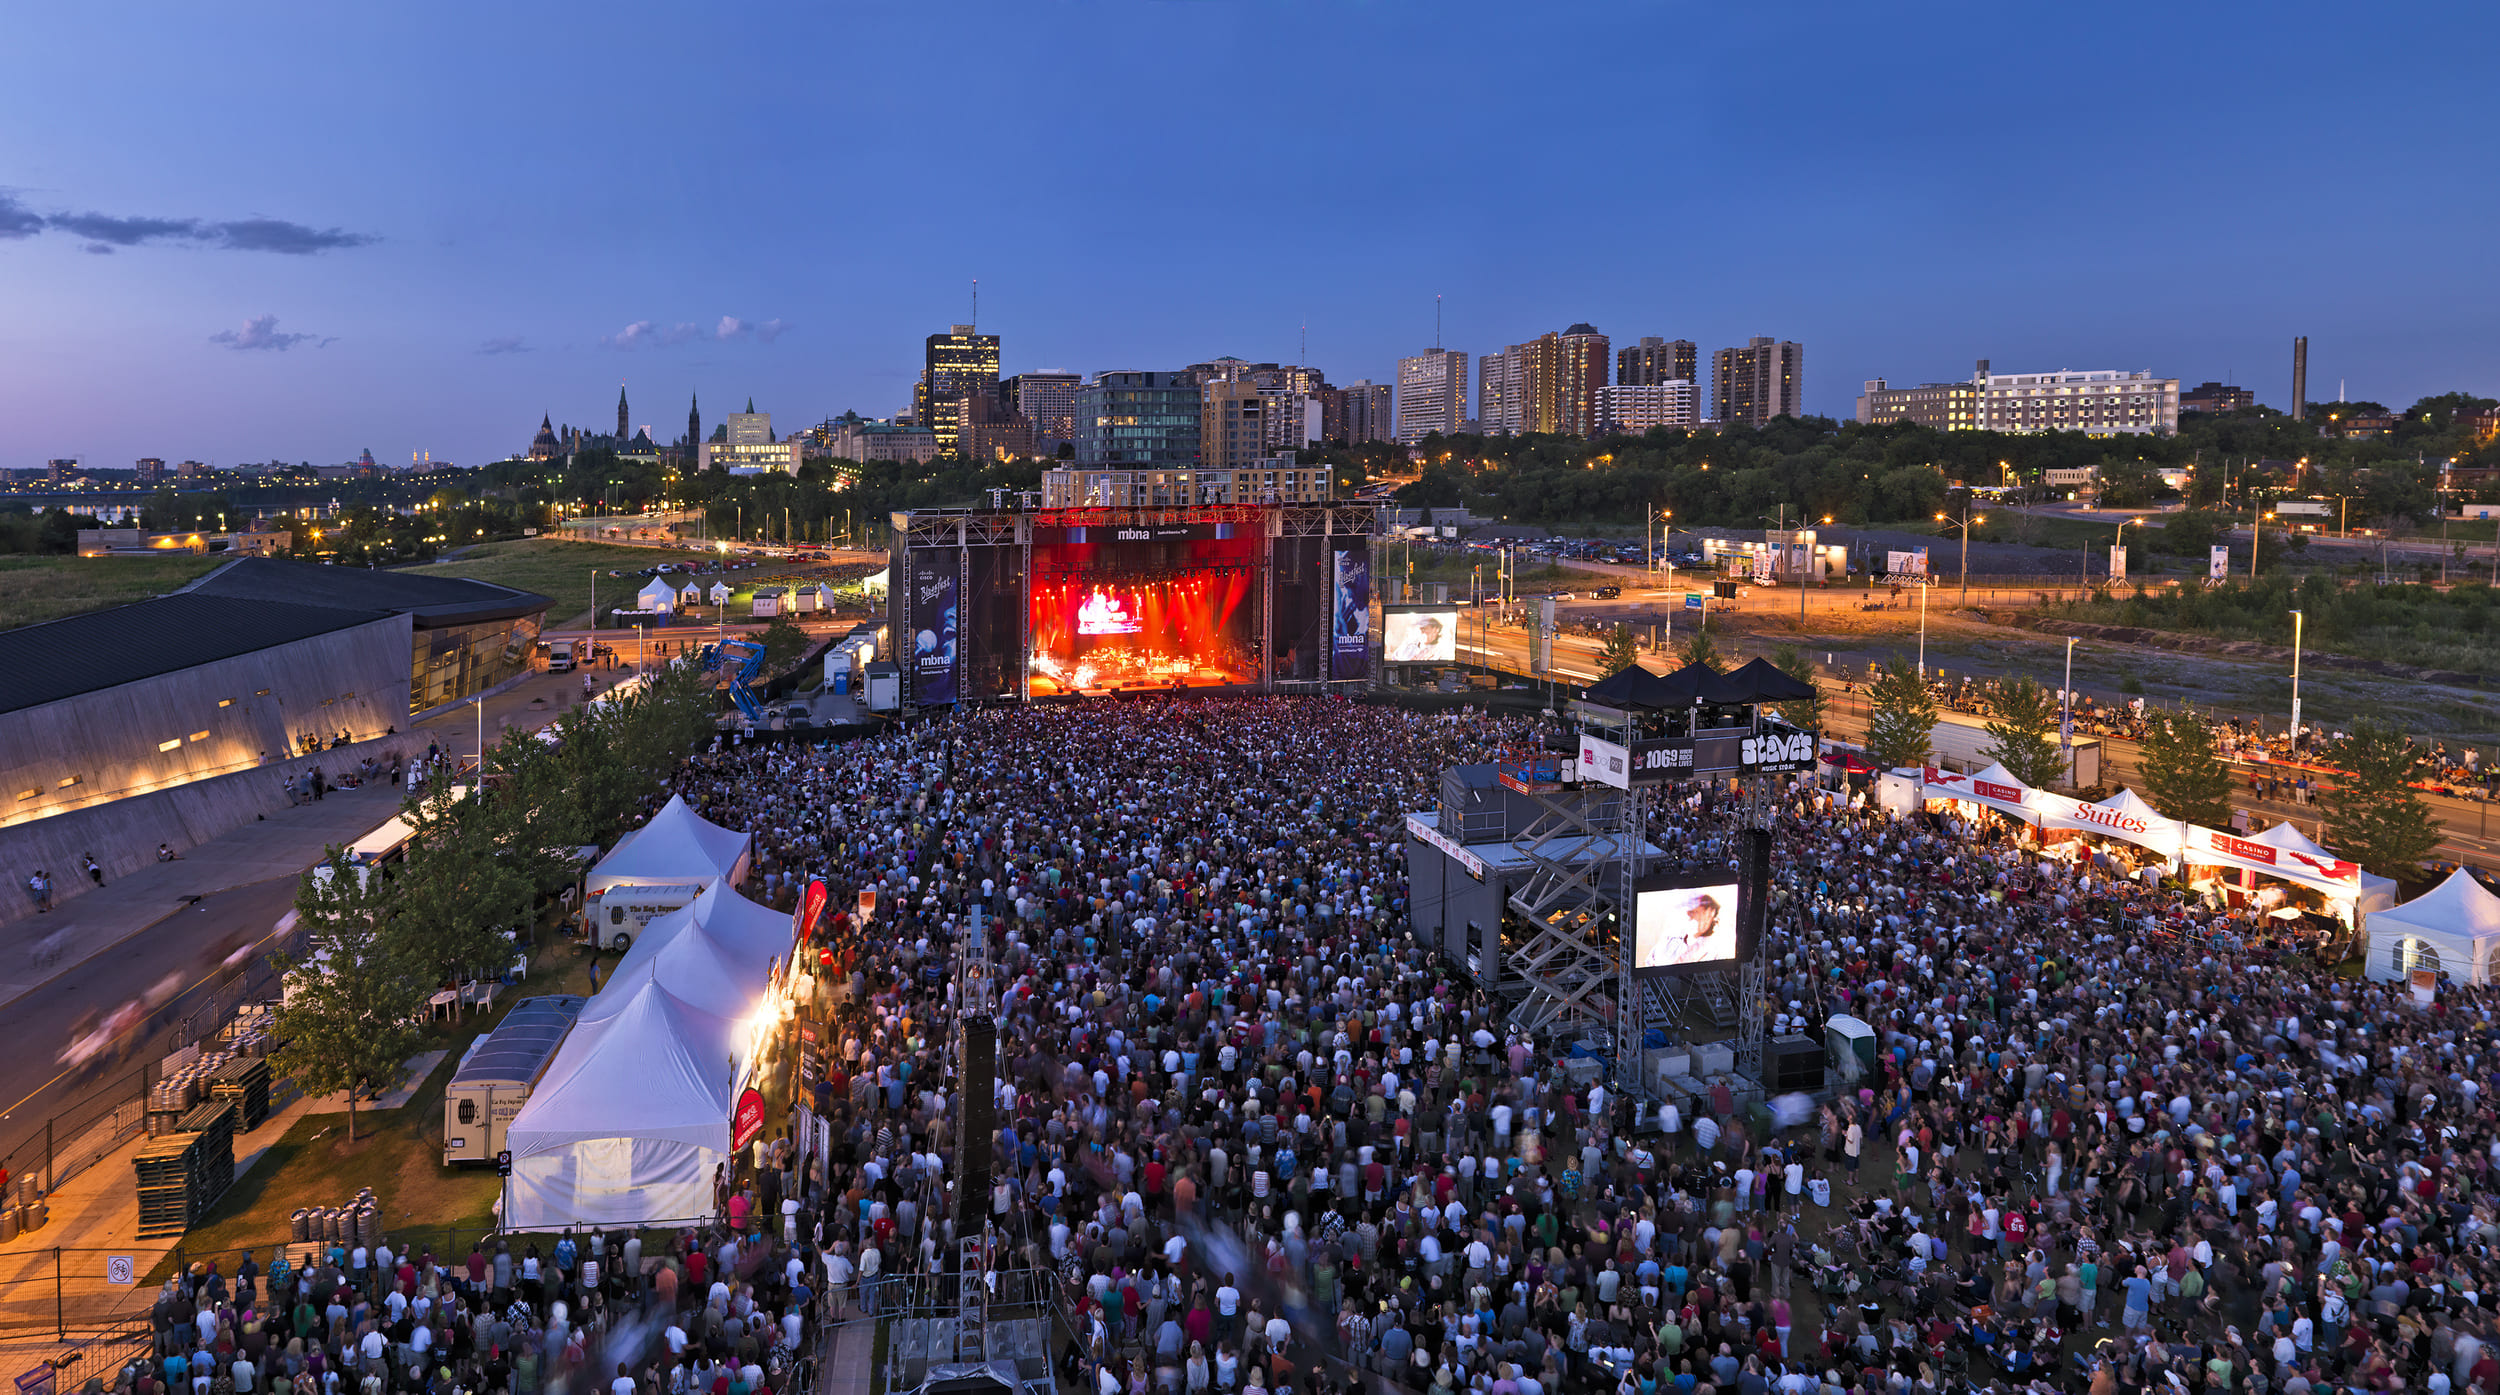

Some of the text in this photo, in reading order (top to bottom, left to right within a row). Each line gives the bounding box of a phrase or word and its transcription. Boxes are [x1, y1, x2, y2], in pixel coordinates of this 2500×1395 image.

[1118, 527, 1150, 540] mbna
[1338, 633, 1365, 644] mbna
[921, 654, 951, 666] mbna
[1992, 787, 2017, 797] CASINO
[2073, 802, 2147, 834] Suites
[2236, 843, 2270, 856] CASINO
[630, 905, 642, 913] The
